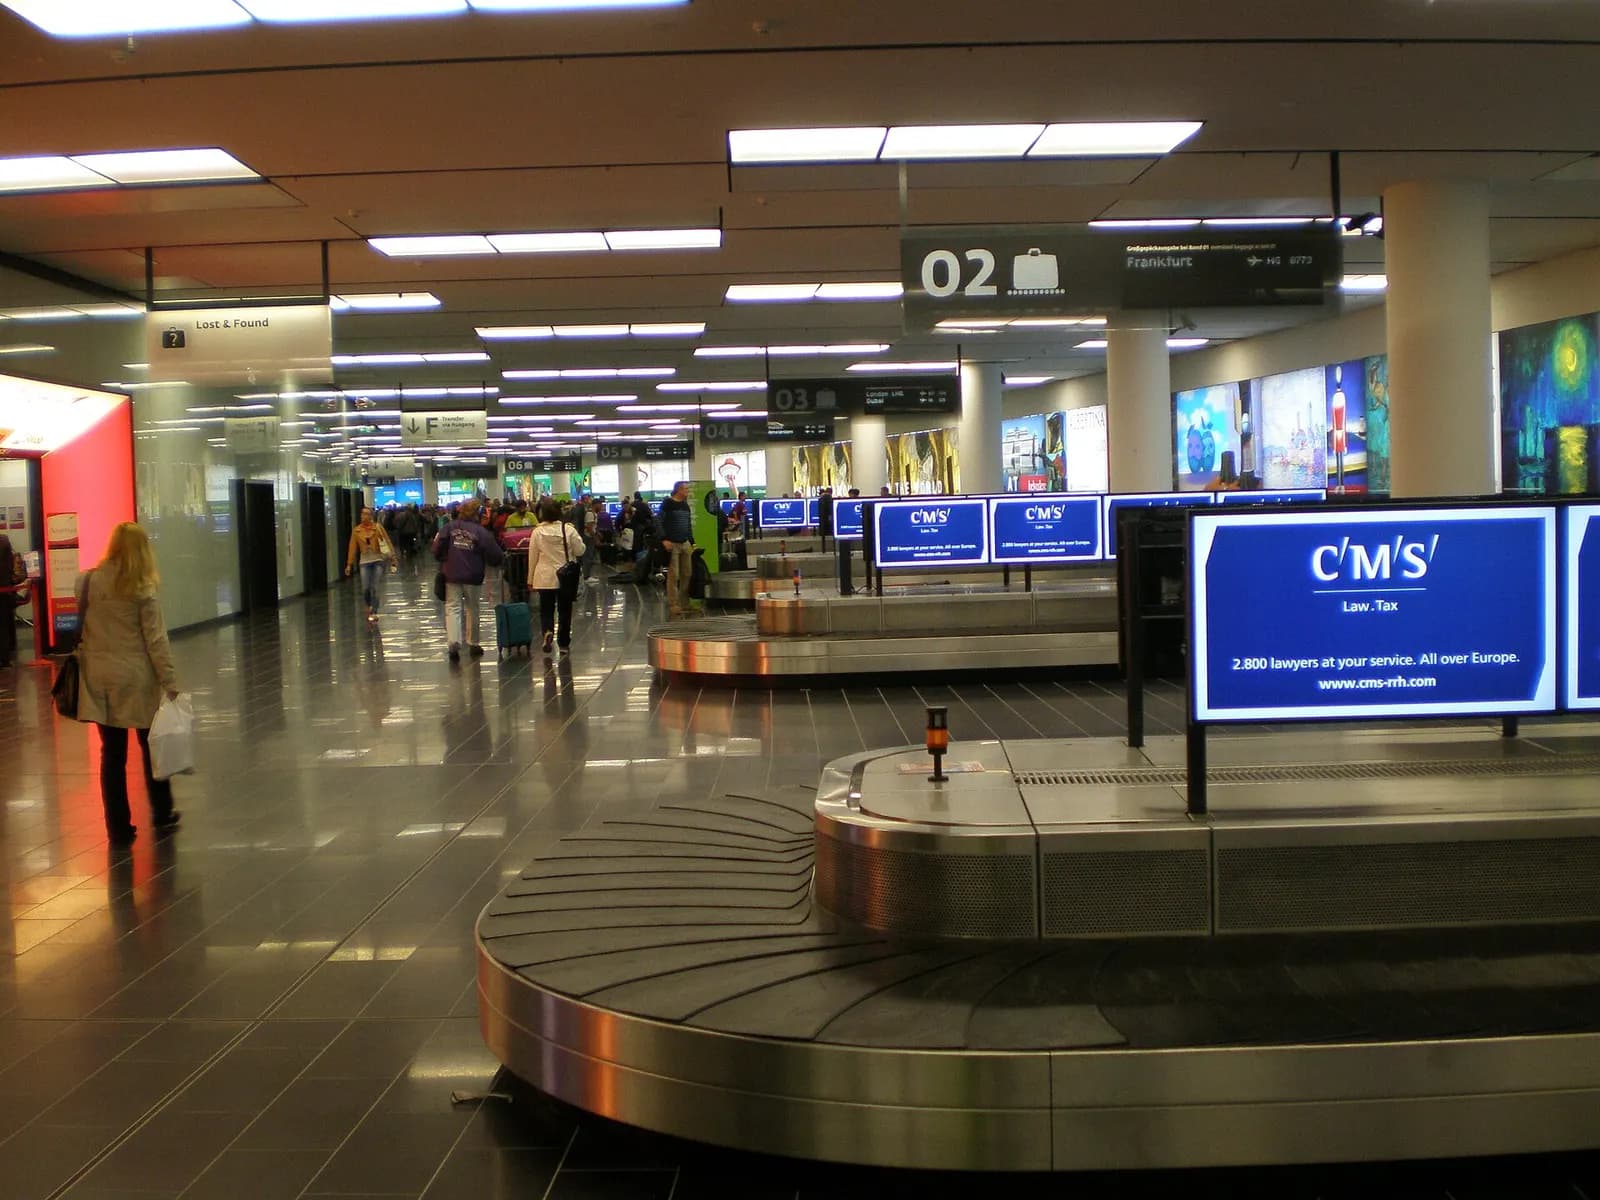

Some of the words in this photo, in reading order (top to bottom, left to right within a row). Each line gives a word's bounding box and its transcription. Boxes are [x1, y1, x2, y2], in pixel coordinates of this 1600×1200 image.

[1127, 255, 1193, 268] Frankfurt
[921, 248, 997, 297] 02
[196, 320, 220, 329] Lost
[223, 319, 231, 329] &
[234, 317, 269, 329] Found
[775, 388, 808, 410] 03
[425, 417, 438, 434] F
[705, 423, 729, 439] 04
[601, 447, 619, 458] 05
[508, 460, 523, 471] 06
[1232, 658, 1268, 670] 2.800
[1270, 657, 1319, 672] lawyers
[1321, 656, 1335, 668] at
[1338, 656, 1368, 670] your
[1370, 654, 1417, 667] service.
[1419, 652, 1437, 665] All
[1440, 654, 1469, 665] over
[1472, 652, 1520, 665] Europe.
[1318, 675, 1437, 690] www.cms-rrh.com
